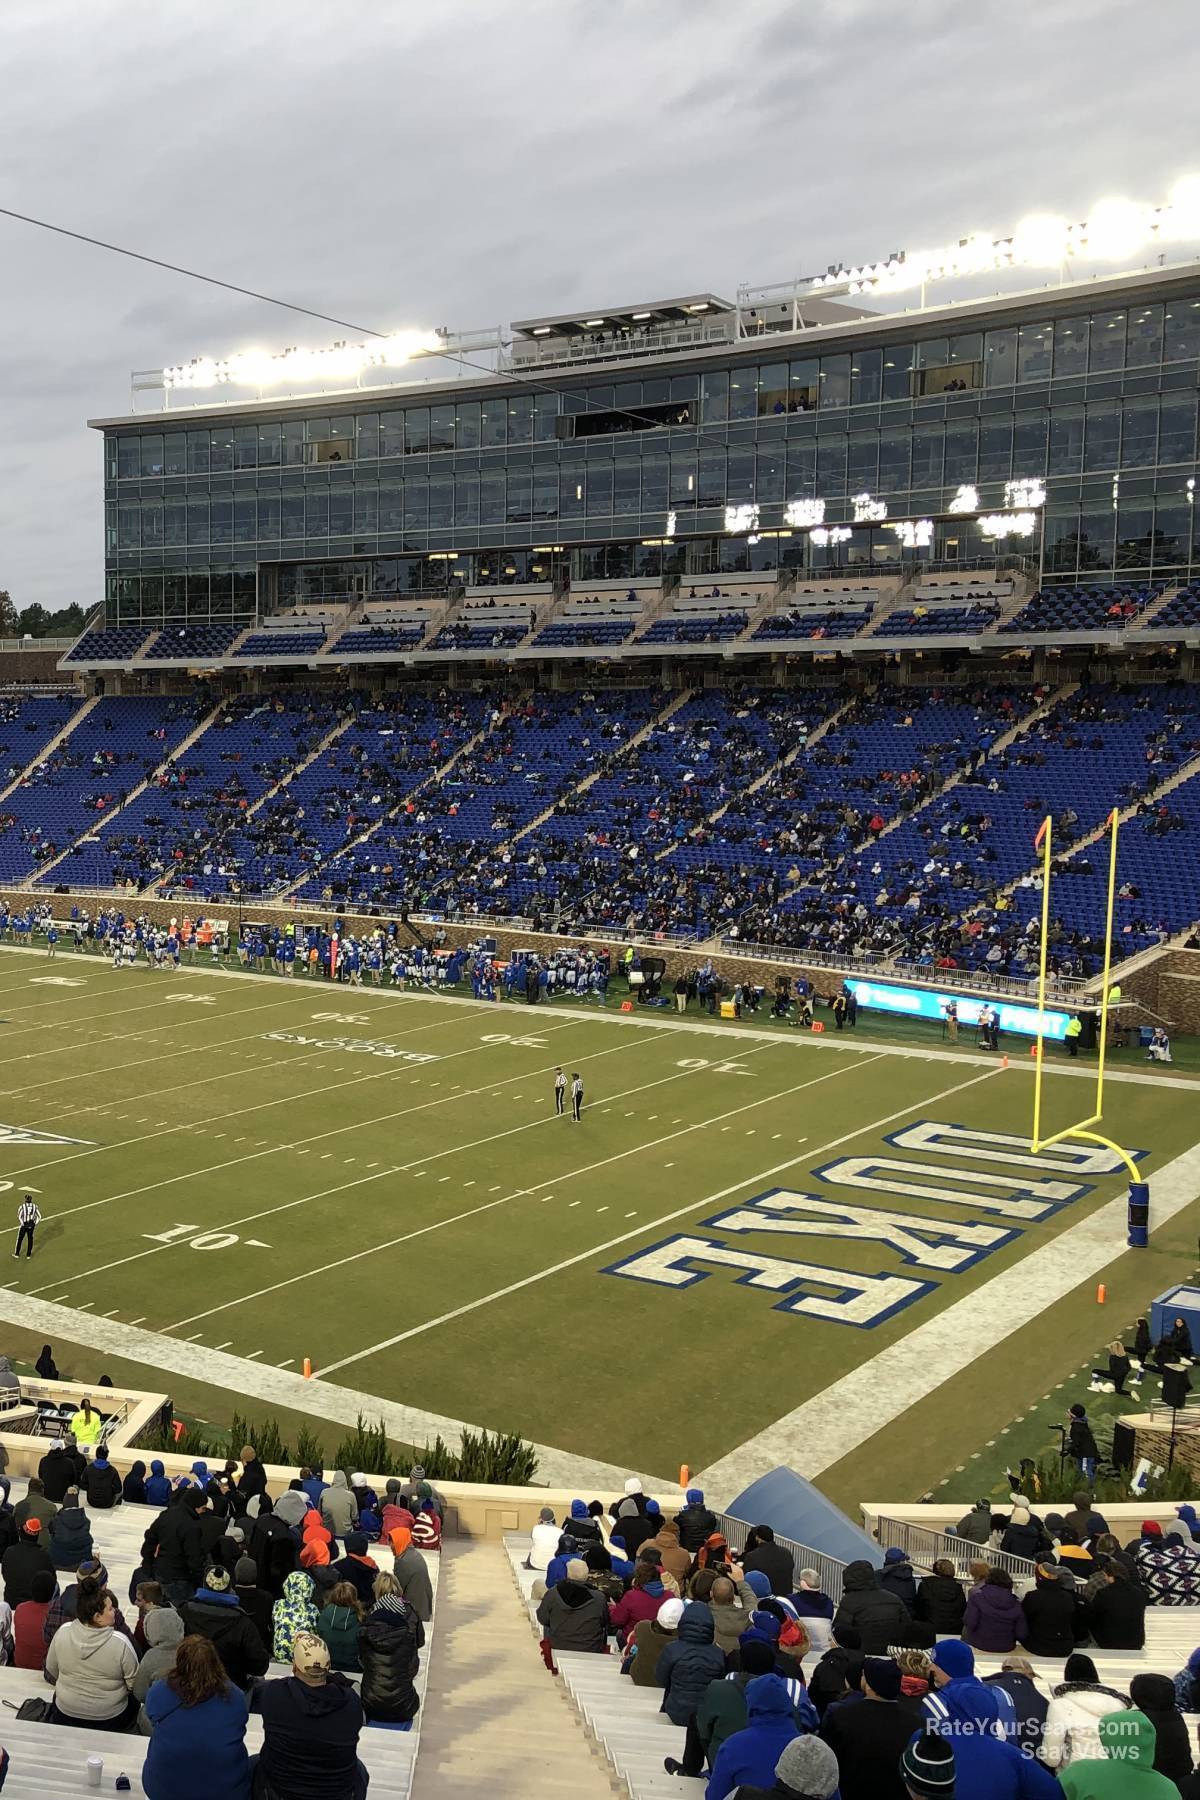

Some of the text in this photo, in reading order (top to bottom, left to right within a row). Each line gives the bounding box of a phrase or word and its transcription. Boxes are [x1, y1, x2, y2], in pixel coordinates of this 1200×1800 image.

[260, 1033, 441, 1062] BROOKS
[141, 1223, 240, 1251] 10
[599, 1119, 1152, 1330] DUKE
